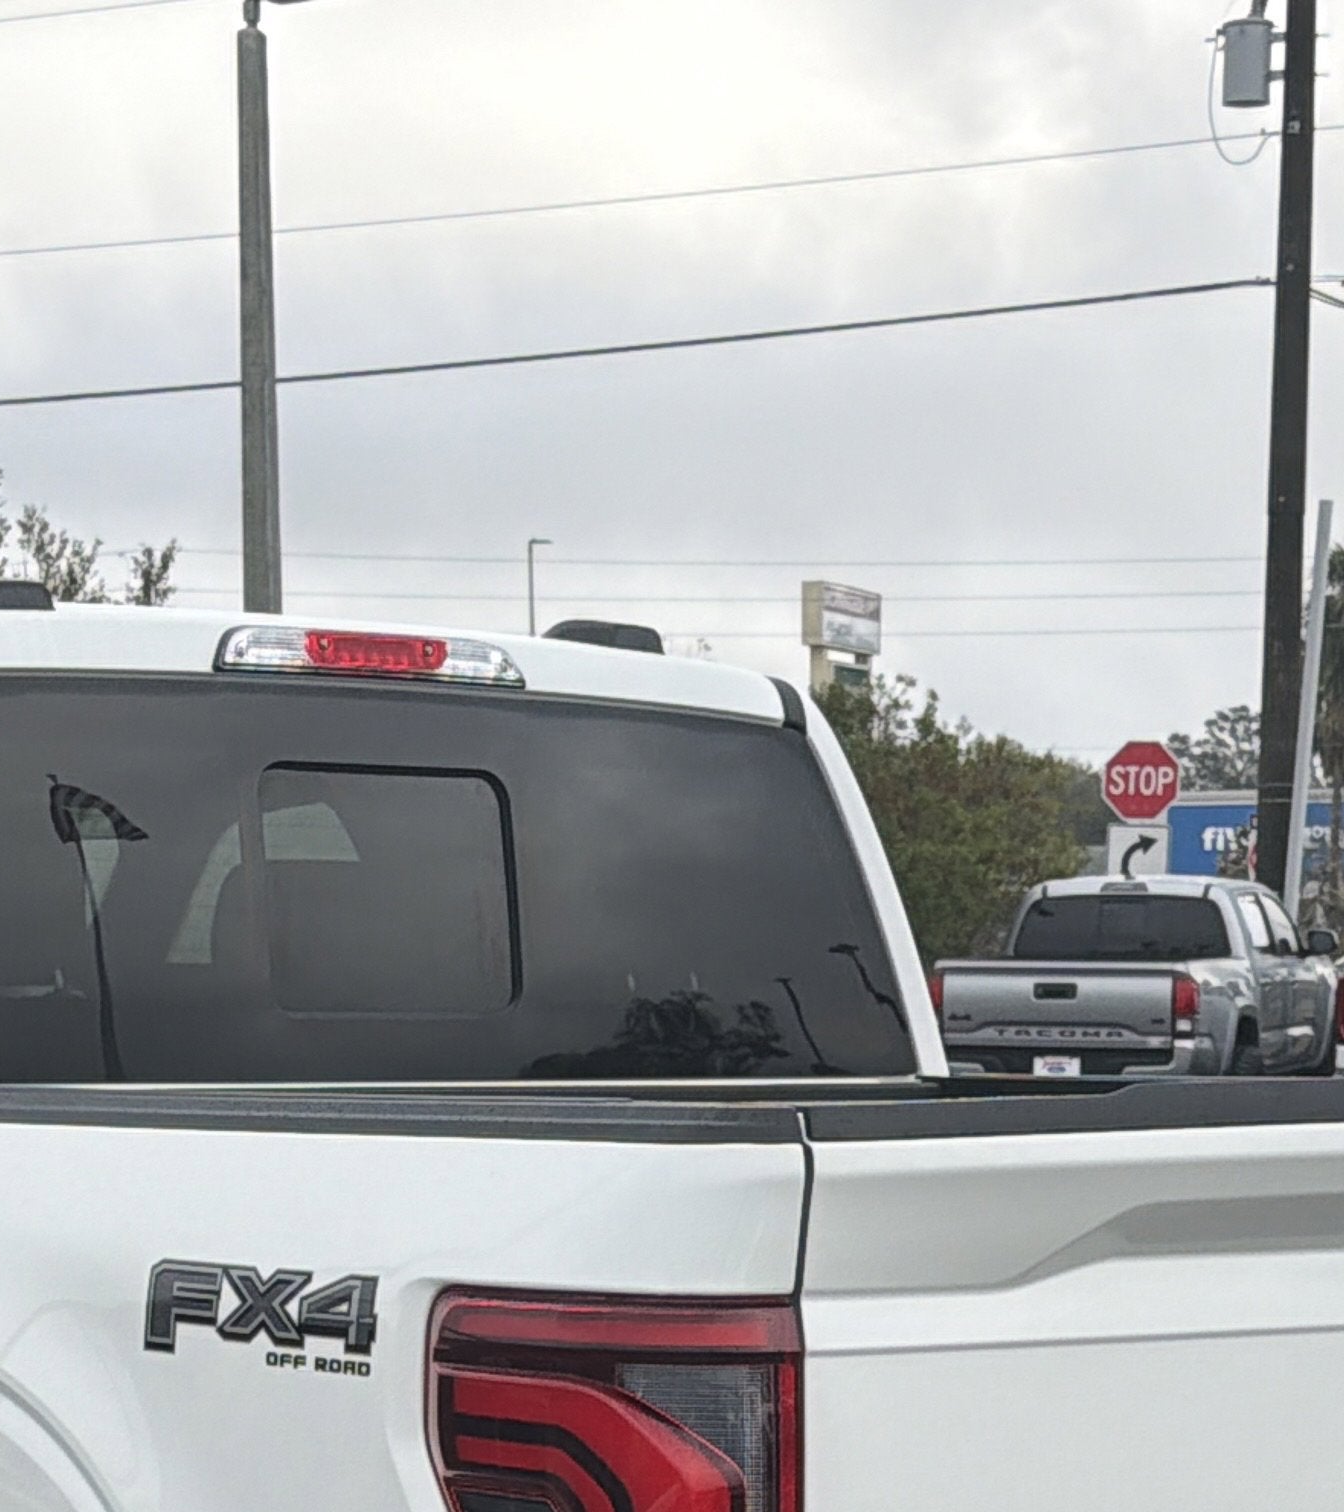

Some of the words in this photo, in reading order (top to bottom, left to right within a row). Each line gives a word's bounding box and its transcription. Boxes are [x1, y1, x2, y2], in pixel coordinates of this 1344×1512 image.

[1109, 765, 1175, 797] STOP
[996, 1027, 1125, 1039] TACOMA
[143, 1258, 380, 1356] FX4
[266, 1351, 308, 1371] OFF
[314, 1356, 372, 1377] ROAD
